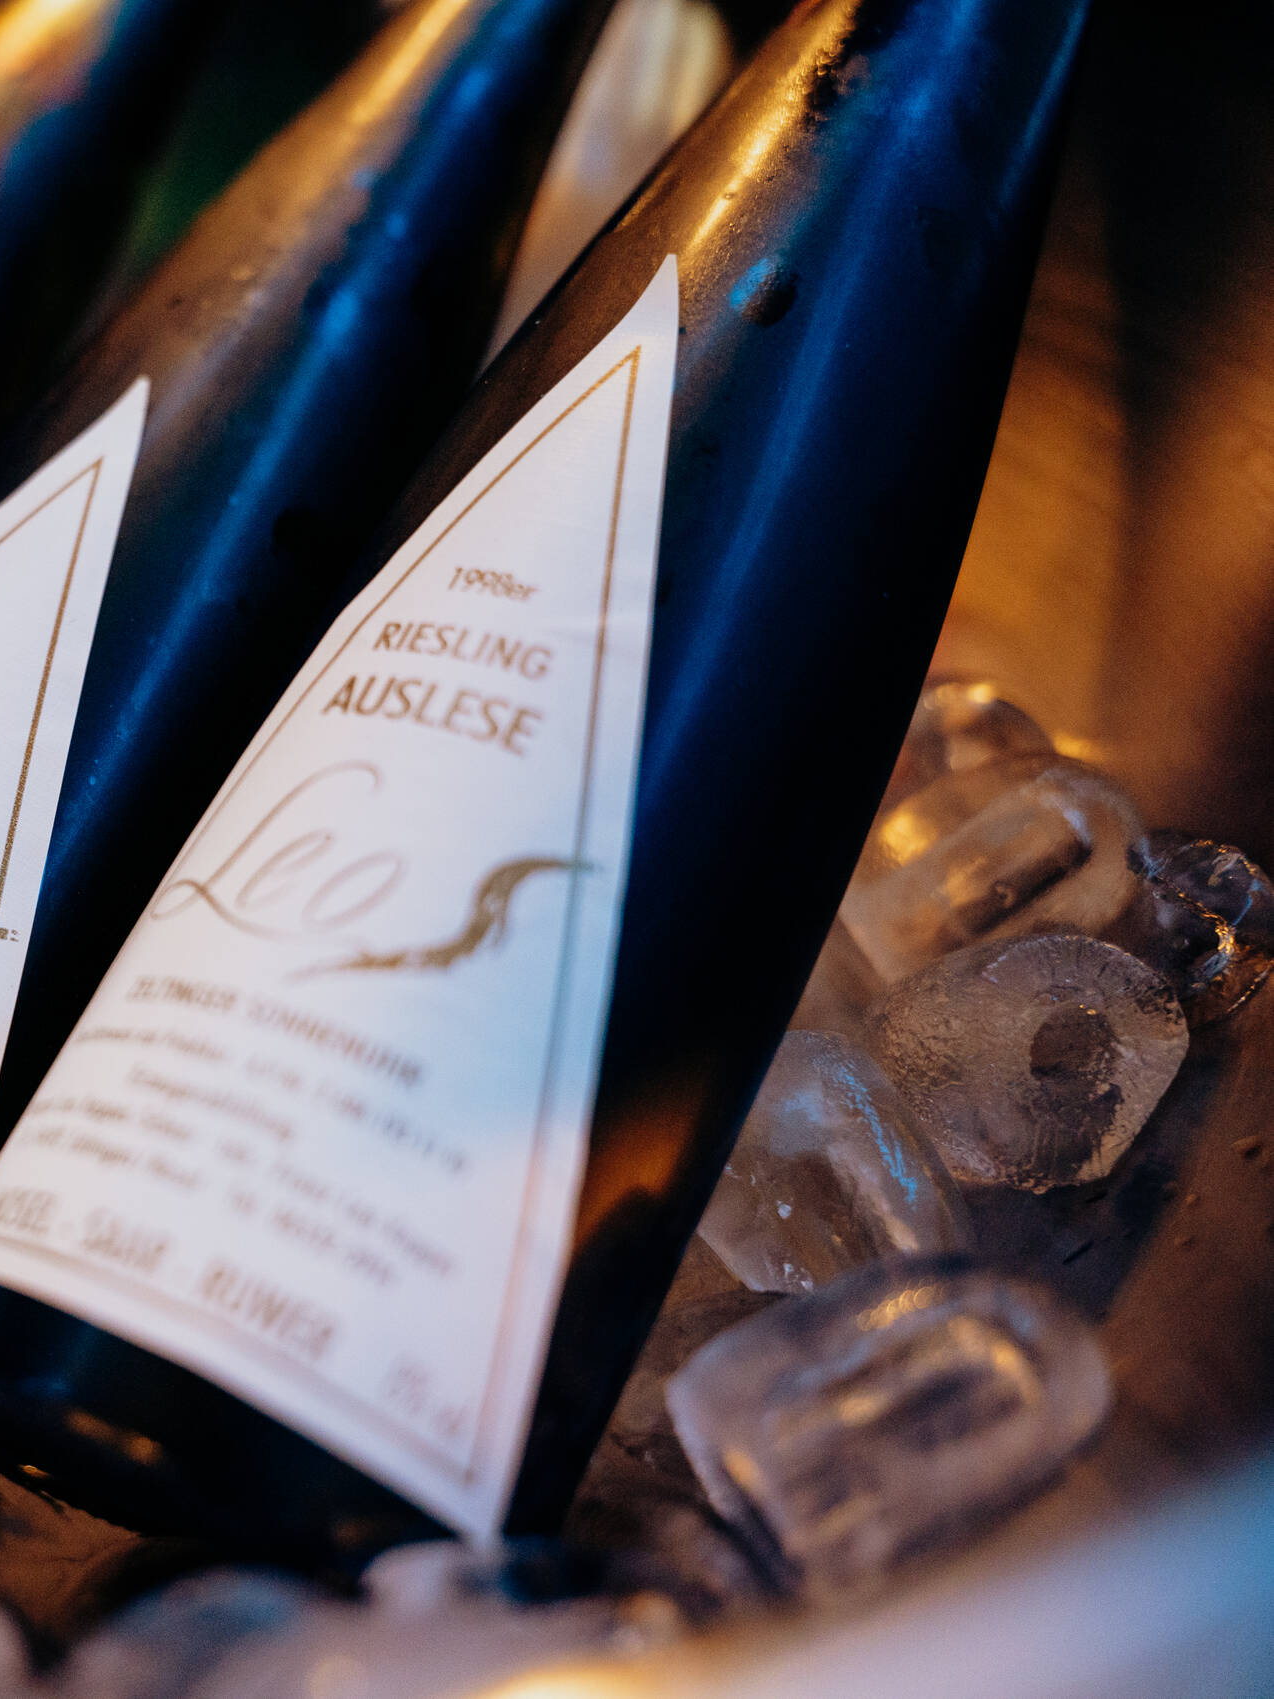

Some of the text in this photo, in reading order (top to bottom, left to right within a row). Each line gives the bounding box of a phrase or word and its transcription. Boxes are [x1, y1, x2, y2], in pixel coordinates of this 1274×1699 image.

[446, 566, 539, 602] 1998er
[372, 621, 553, 681] RIESLING
[322, 673, 545, 758] AUSLESE
[149, 759, 406, 942] Leo
